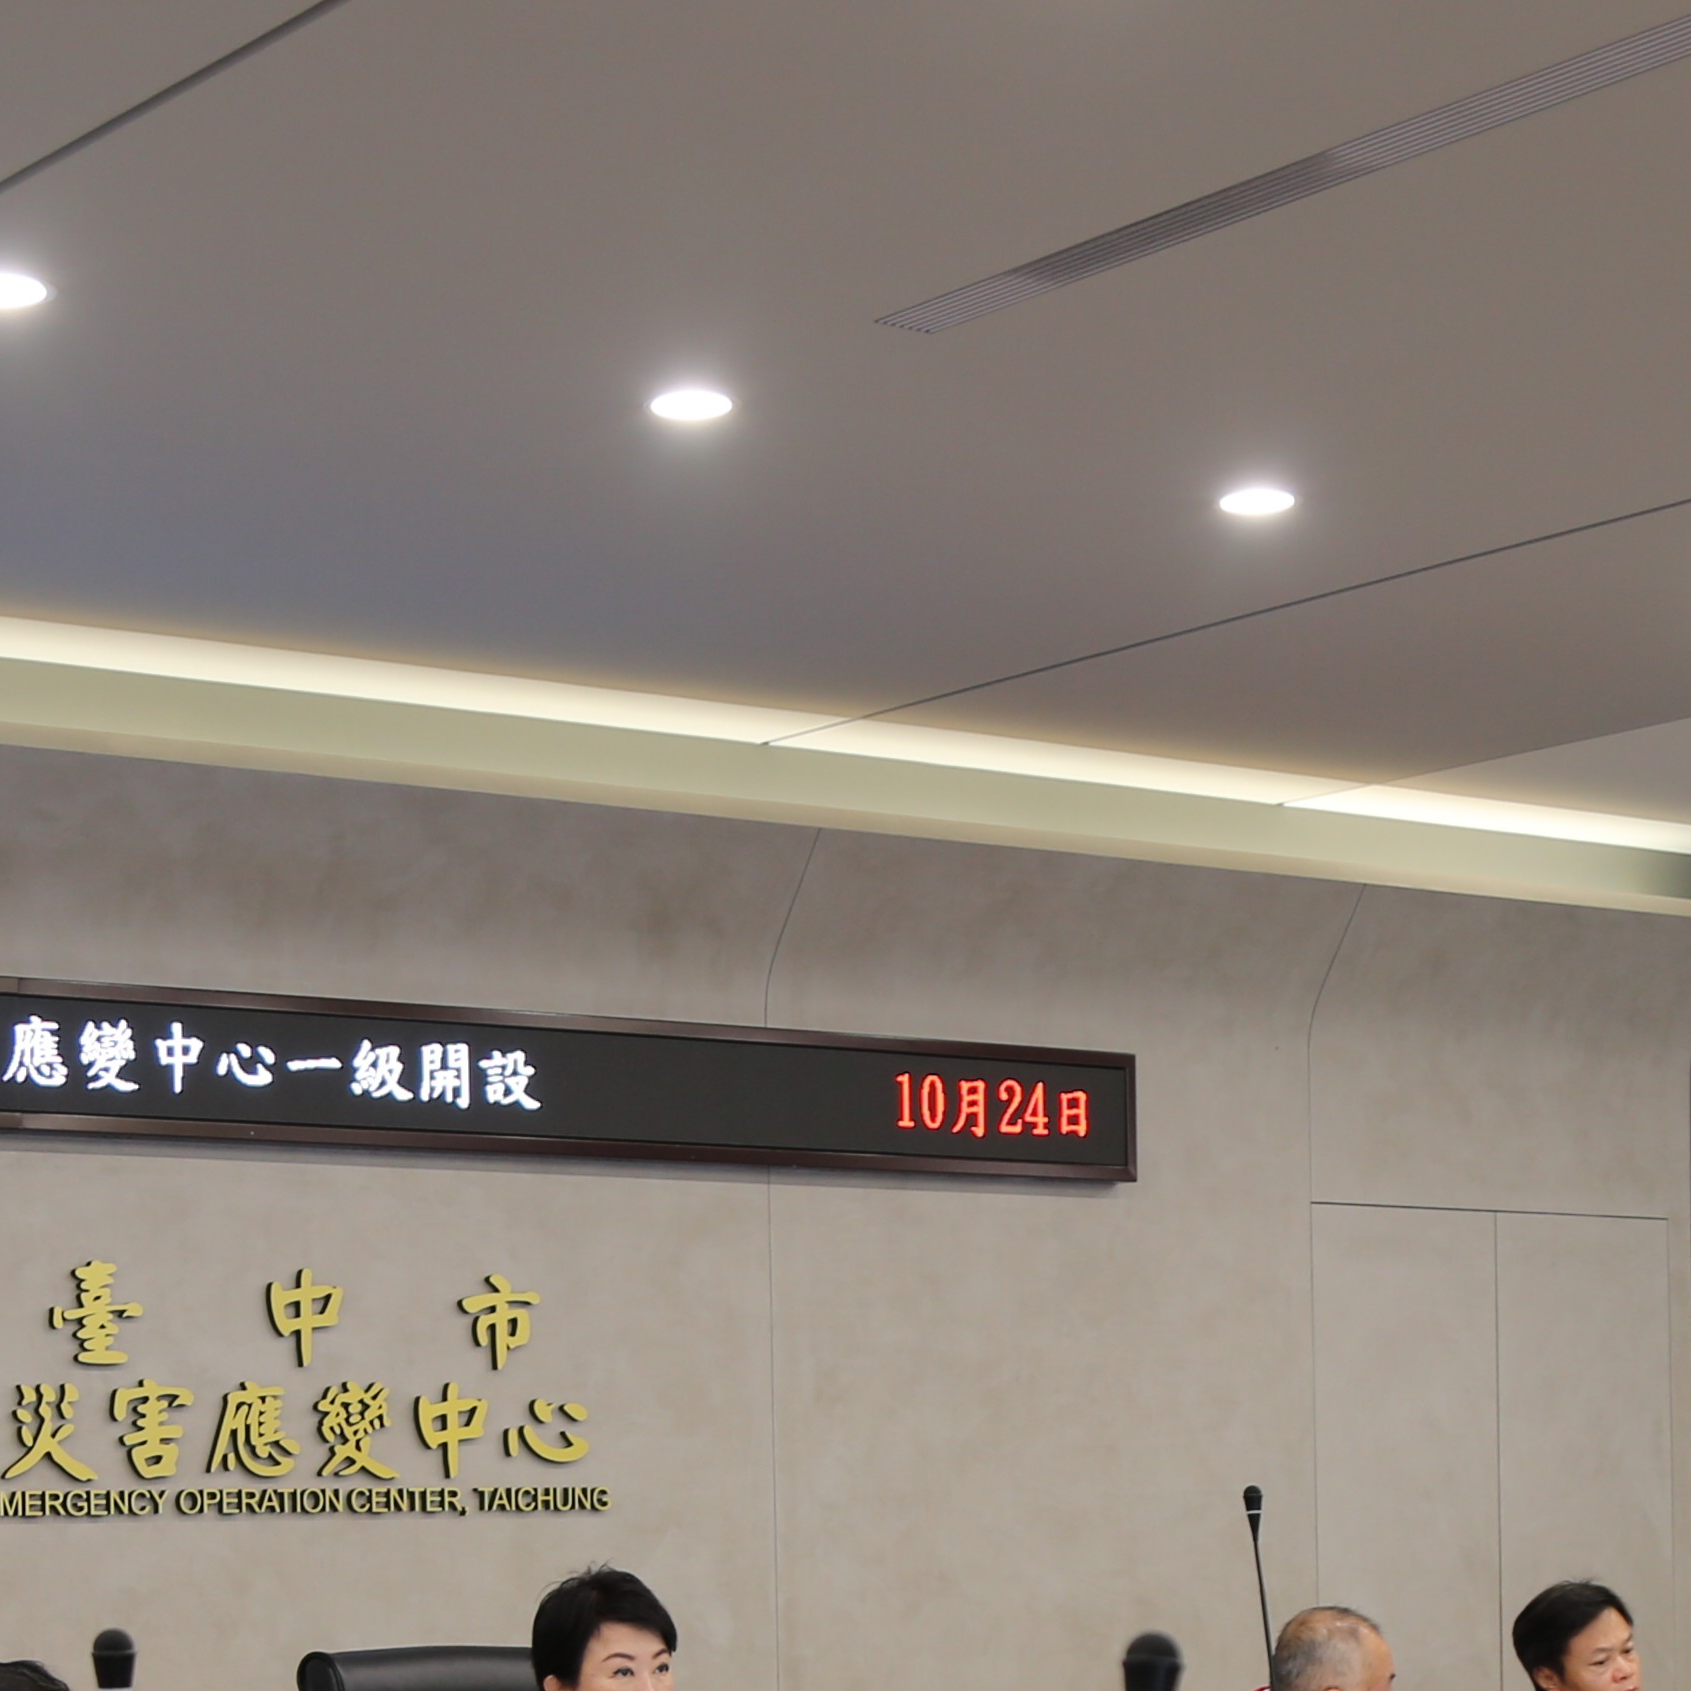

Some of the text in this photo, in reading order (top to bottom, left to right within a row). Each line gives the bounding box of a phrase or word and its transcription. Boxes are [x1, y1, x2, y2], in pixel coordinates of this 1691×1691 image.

[894, 1071, 1091, 1139] 10月24日
[49, 1260, 541, 1369] 臺中市
[1, 1379, 591, 1482] 災害應變中心
[176, 1488, 343, 1516] OPERATION
[346, 1488, 468, 1516] CENTER,
[476, 1486, 612, 1513] TAICHUNG
